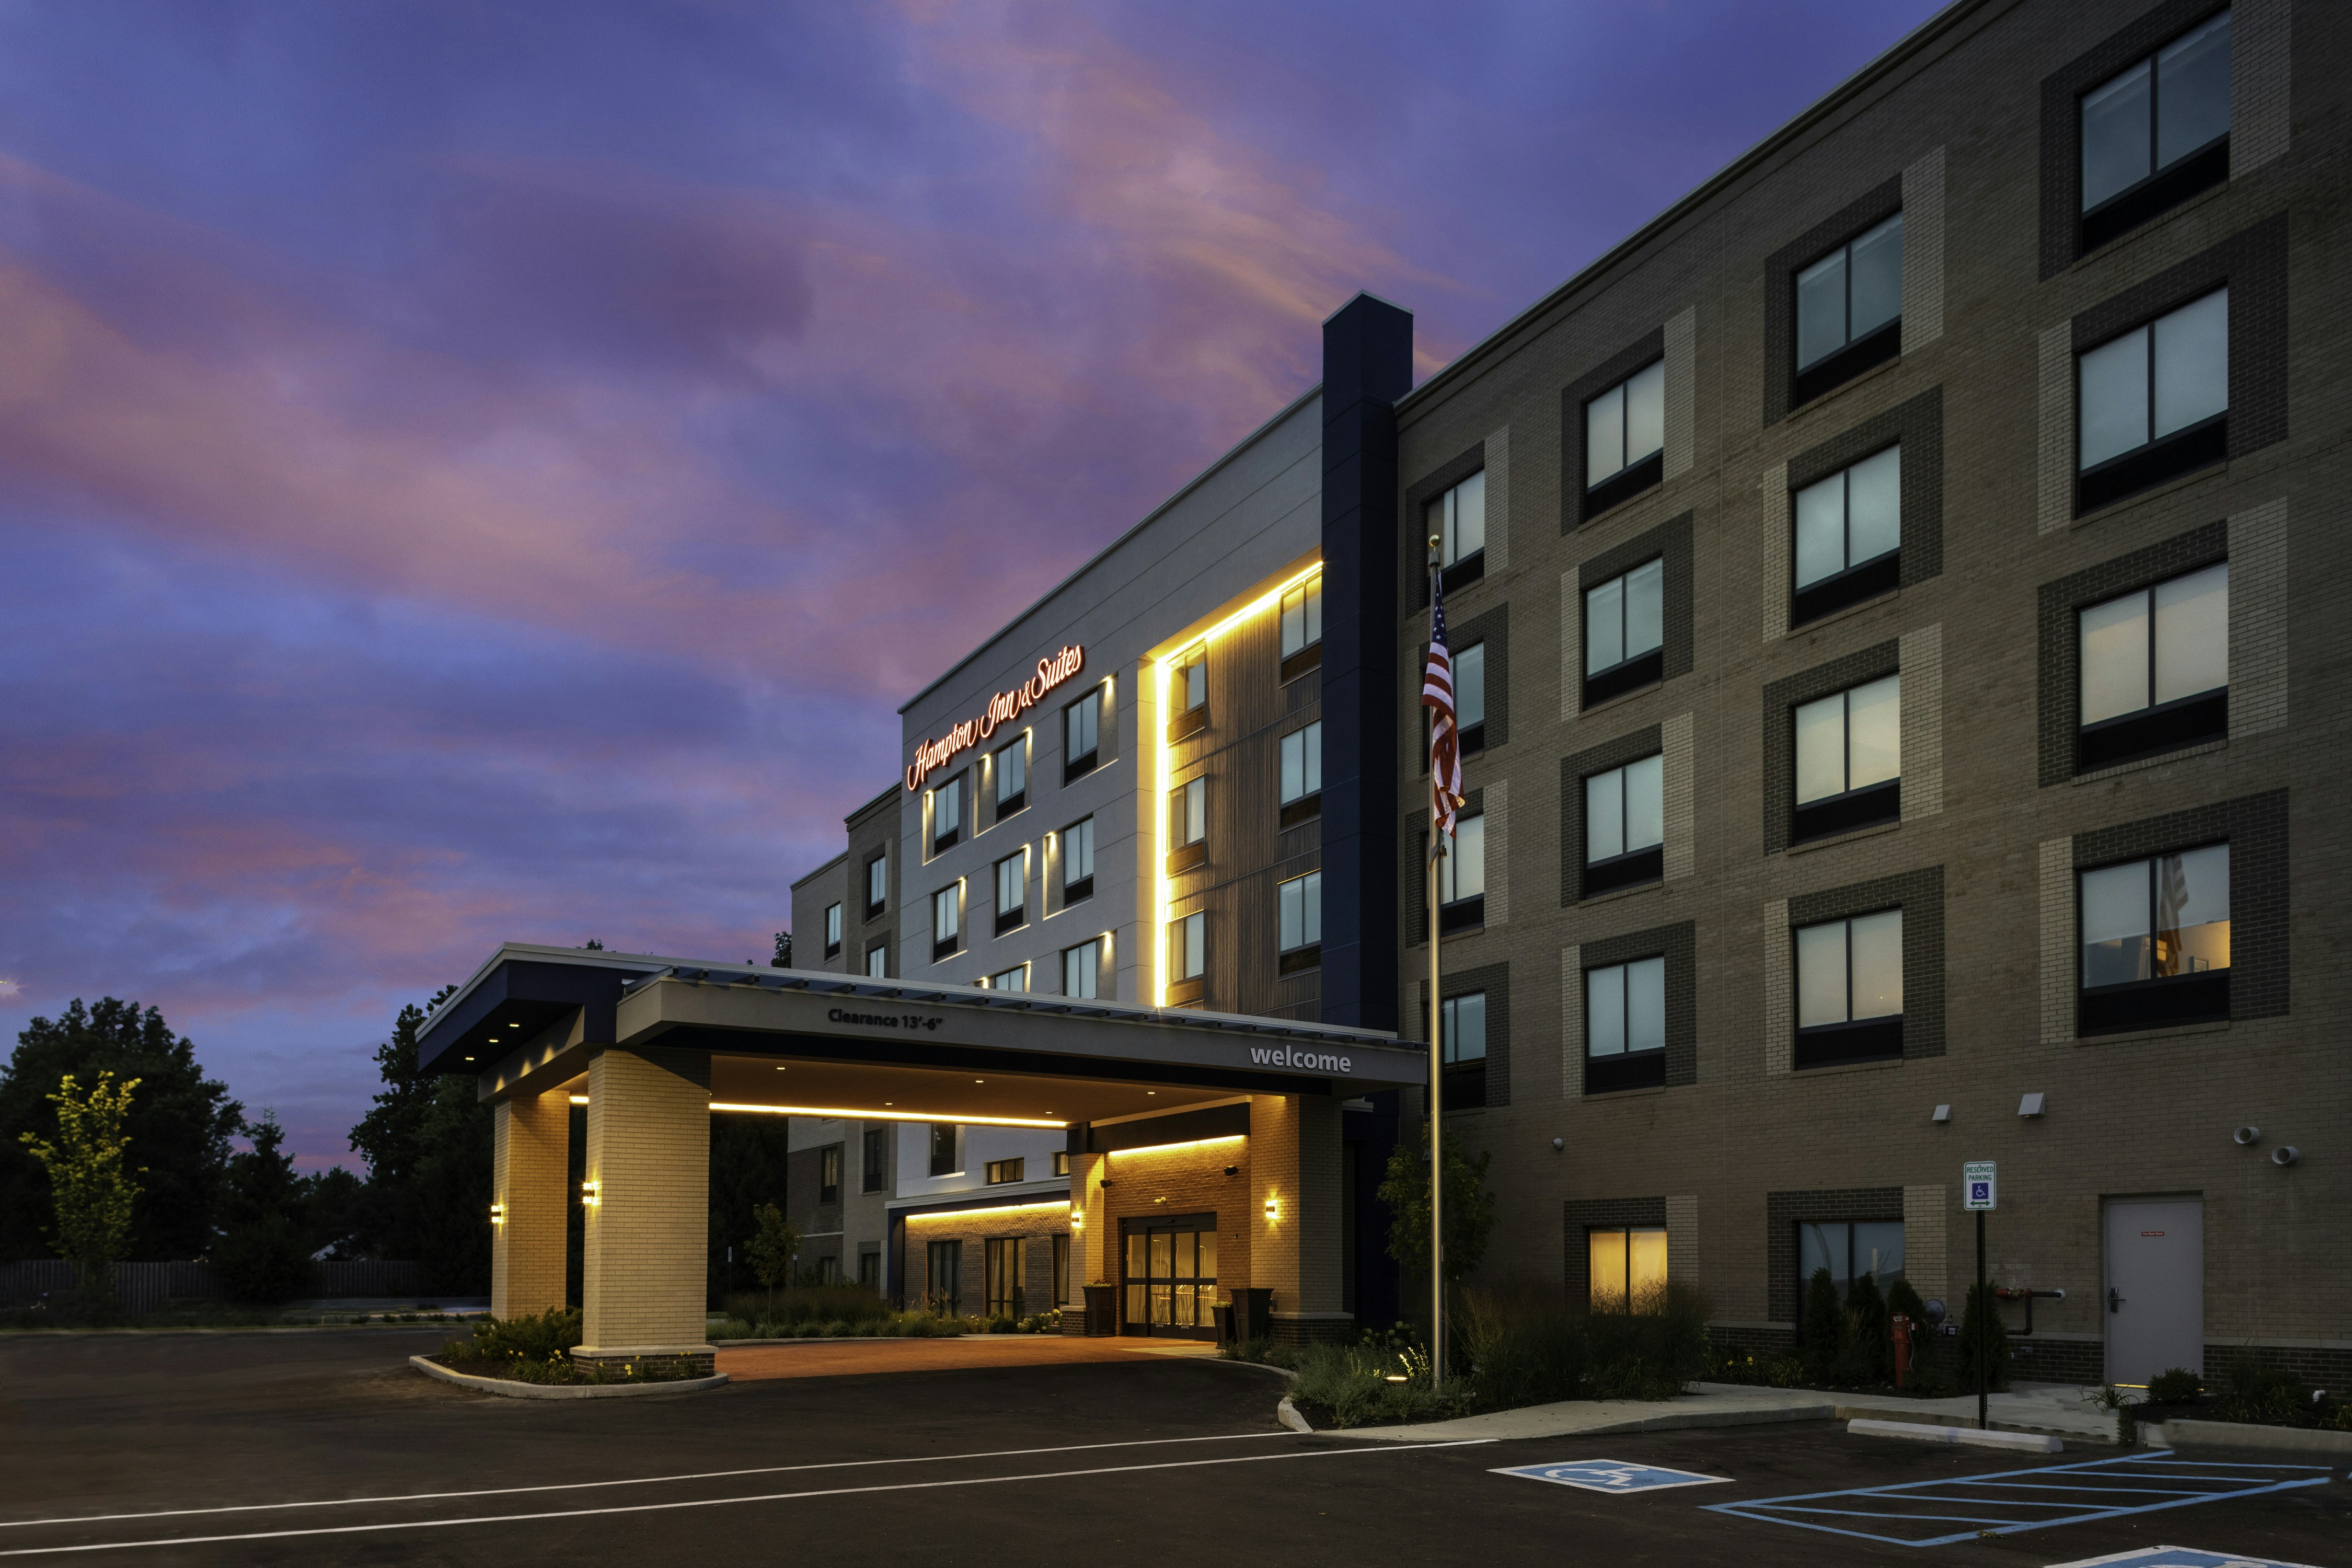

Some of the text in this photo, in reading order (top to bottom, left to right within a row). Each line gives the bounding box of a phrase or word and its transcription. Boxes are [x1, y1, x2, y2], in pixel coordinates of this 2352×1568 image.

[907, 644, 1082, 791] Hampton Inn & Suites
[828, 1008, 898, 1027] Clearance
[1250, 1045, 1351, 1072] welcome
